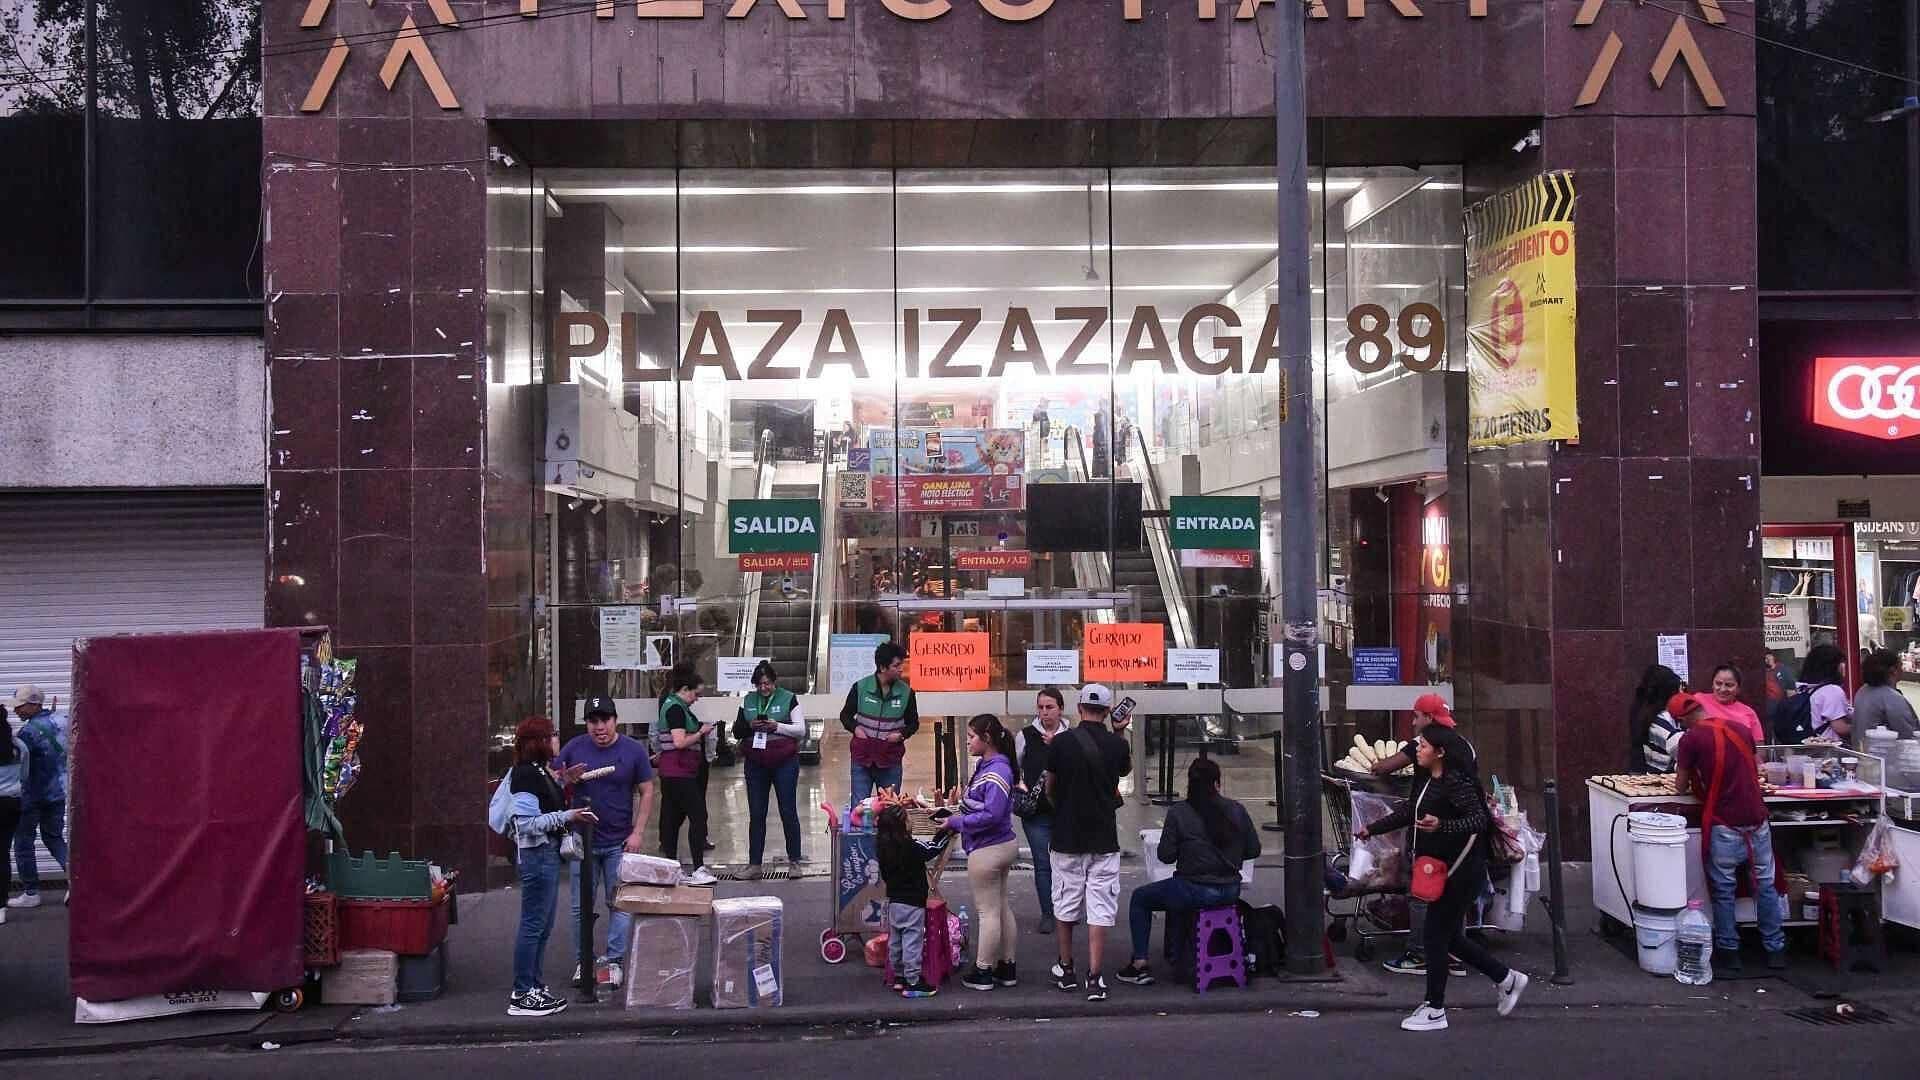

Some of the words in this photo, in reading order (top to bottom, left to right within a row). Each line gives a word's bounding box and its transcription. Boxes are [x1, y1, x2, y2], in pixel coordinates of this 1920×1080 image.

[554, 308, 869, 382] PLAZA
[1345, 303, 1446, 374] 89
[734, 516, 816, 534] SALIDA
[1176, 517, 1255, 530] ENTRADA
[743, 558, 784, 567] SALIDA
[961, 556, 1006, 566] ENTRADA
